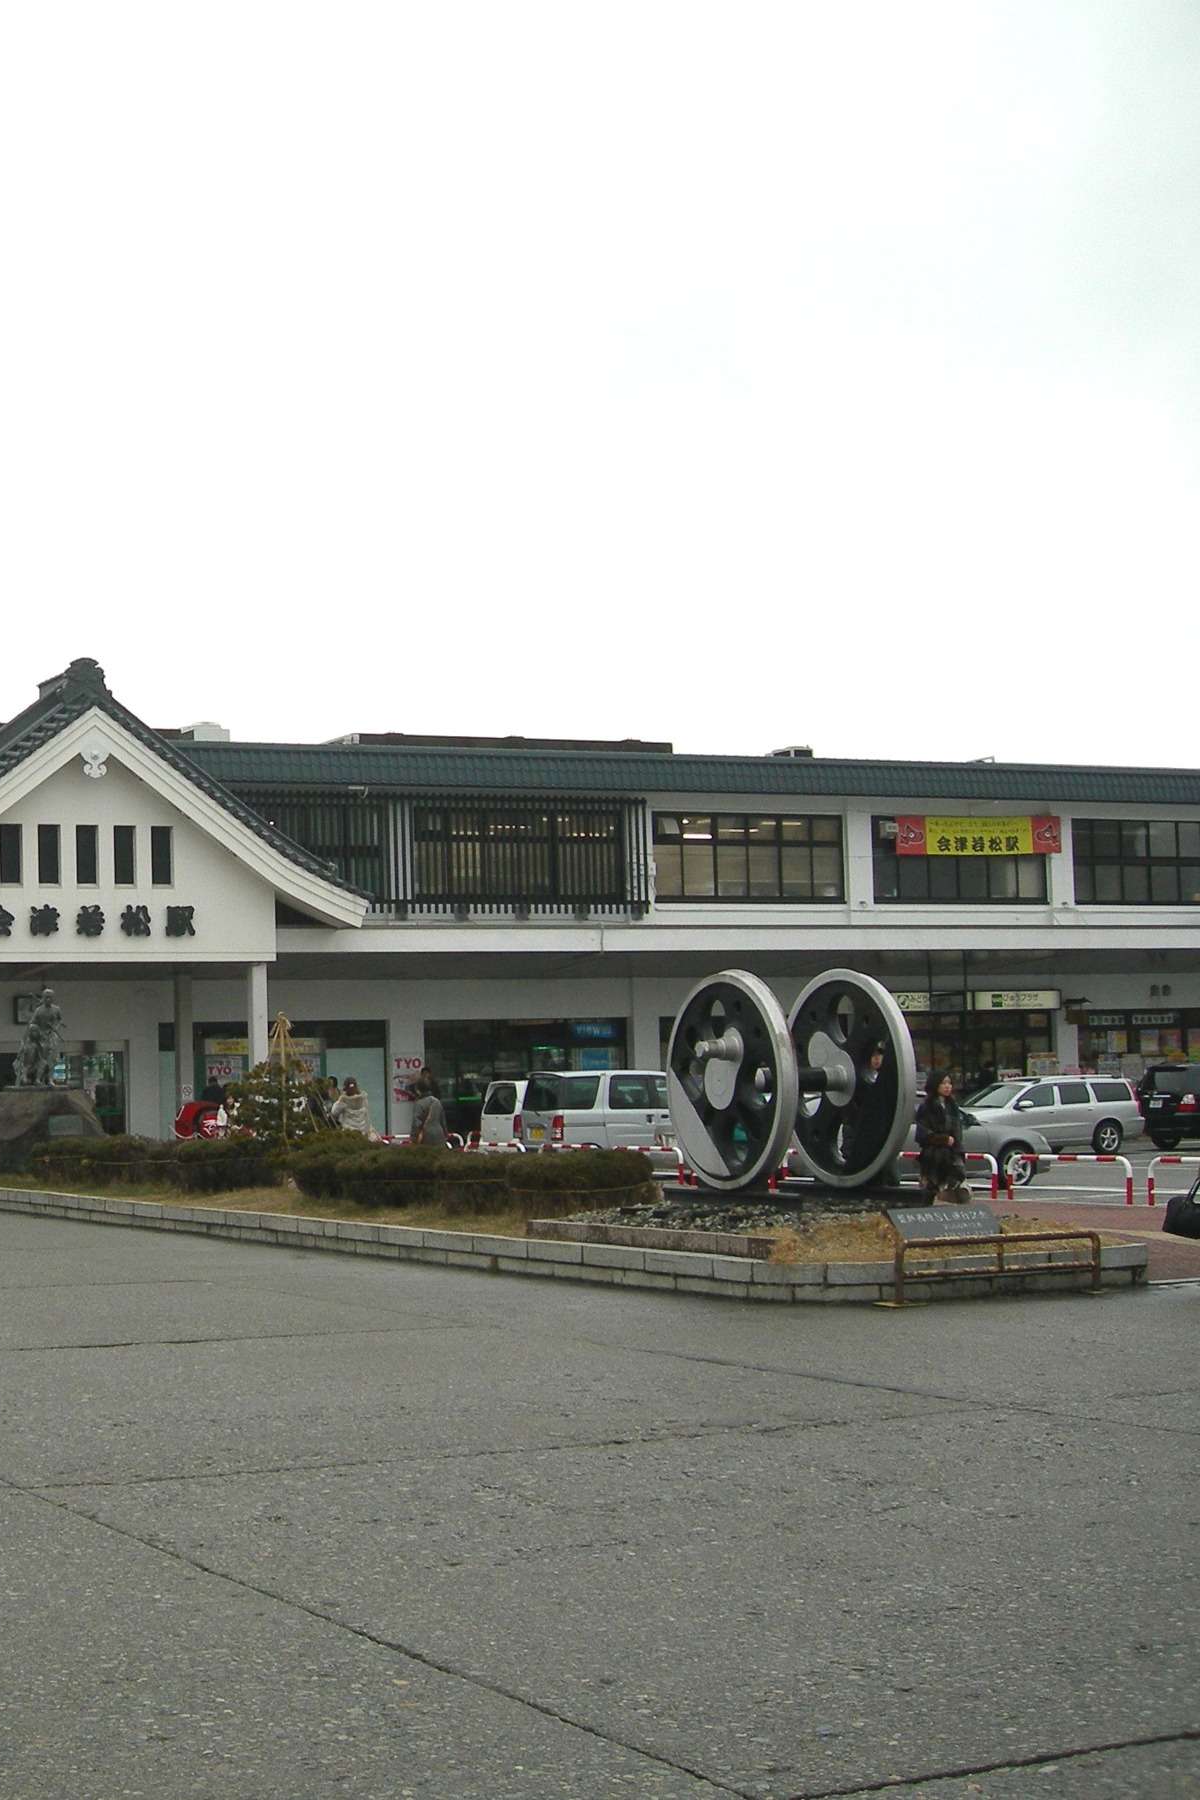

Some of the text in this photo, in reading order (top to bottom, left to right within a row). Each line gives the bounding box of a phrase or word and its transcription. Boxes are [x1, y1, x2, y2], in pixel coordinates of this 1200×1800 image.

[936, 836, 1020, 853] 会津若松駅
[394, 1057, 422, 1069] TYO
[208, 1065, 232, 1076] TYO
